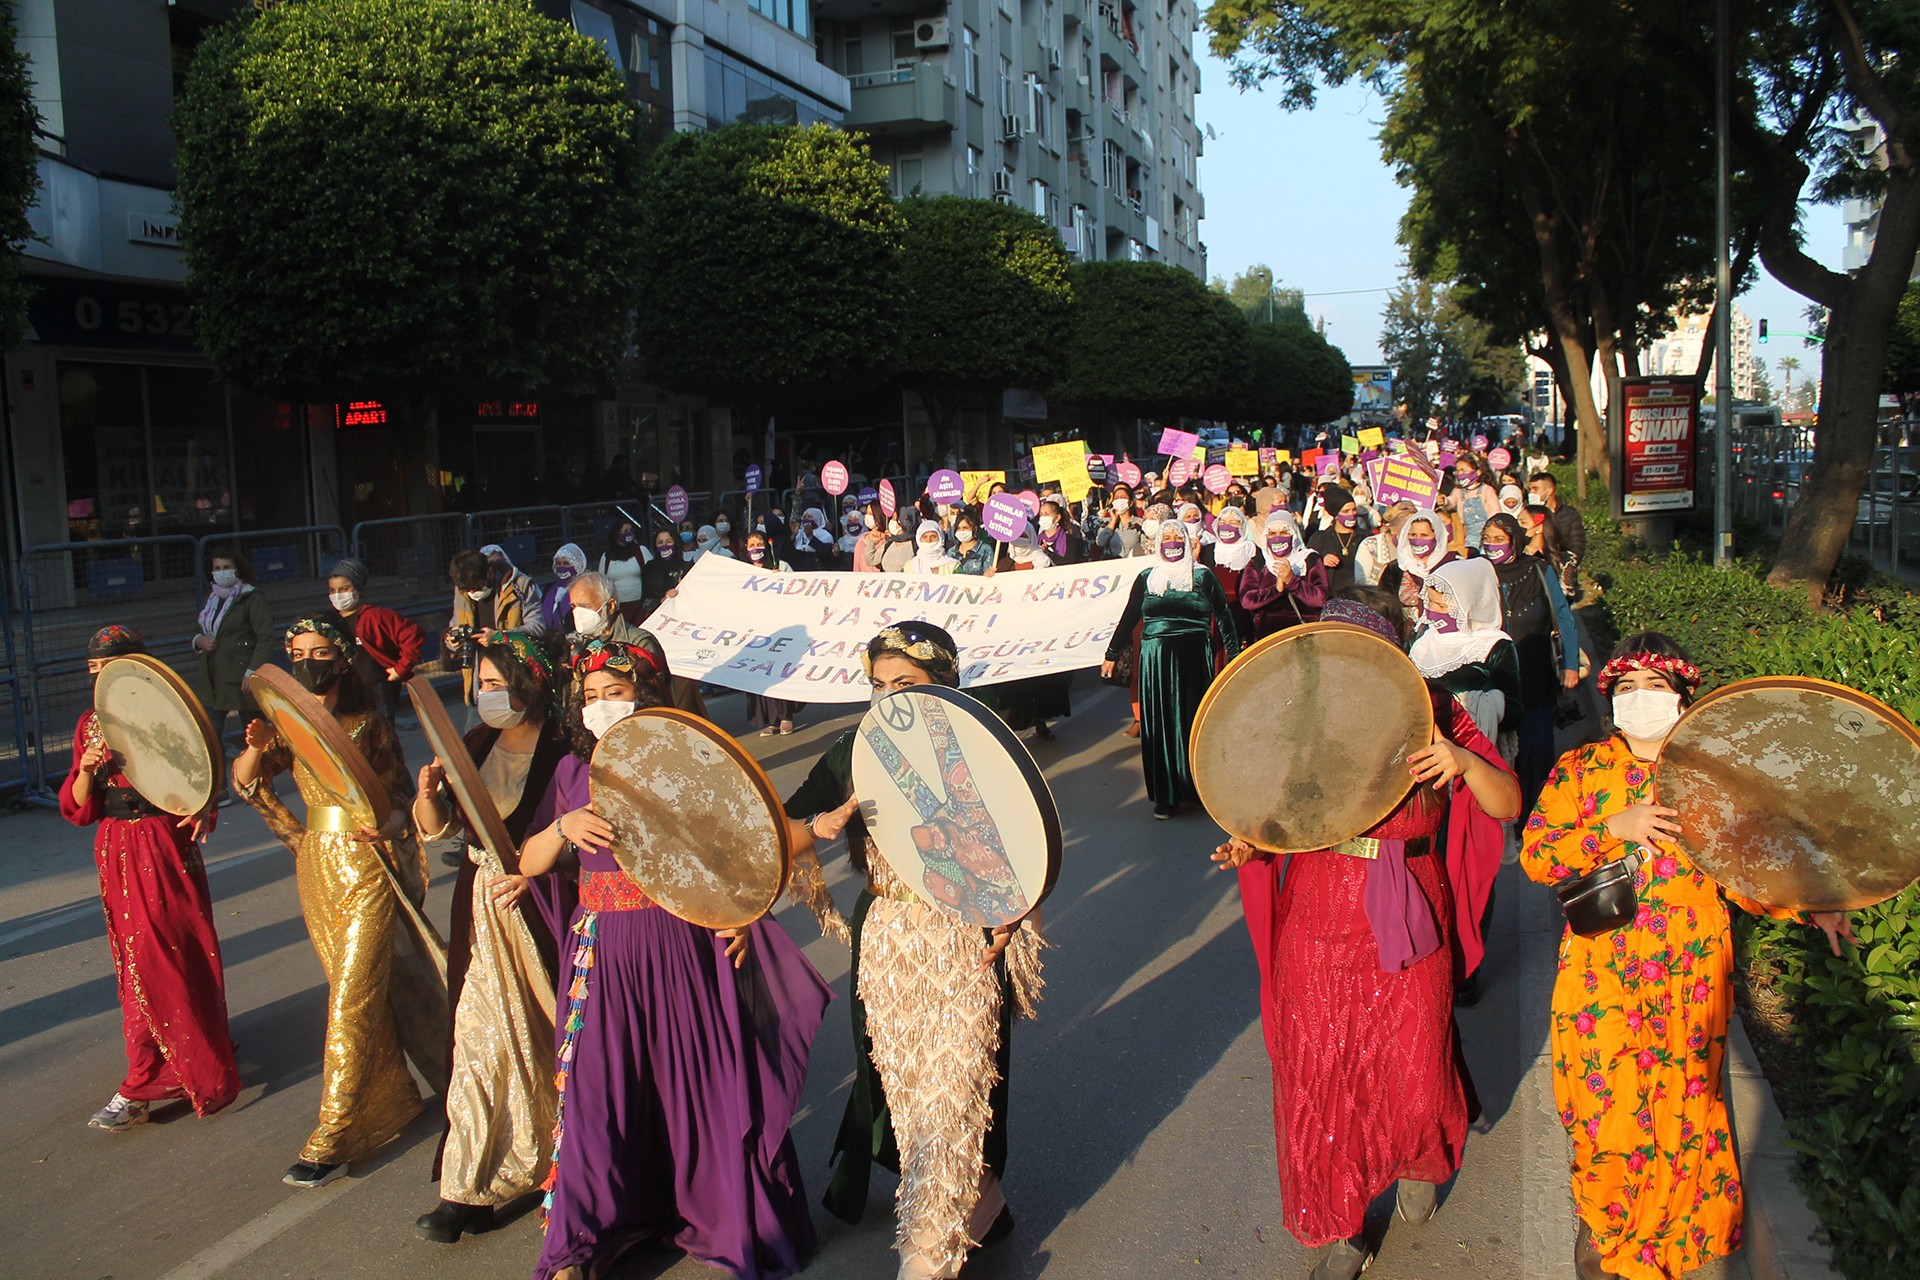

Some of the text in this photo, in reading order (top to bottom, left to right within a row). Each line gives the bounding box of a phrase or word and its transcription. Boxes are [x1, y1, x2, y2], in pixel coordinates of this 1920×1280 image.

[75, 296, 102, 331] 0
[346, 409, 386, 425] APART
[1629, 407, 1690, 421] BURSLULUK
[1628, 419, 1689, 442] SINAVI
[989, 499, 1024, 519] KADINLAR
[988, 519, 1014, 538] İSTİYOR
[993, 512, 1014, 528] BARIŞ
[741, 574, 840, 598] KADIN
[805, 639, 869, 660] KAR
[965, 845, 993, 862] WAR
